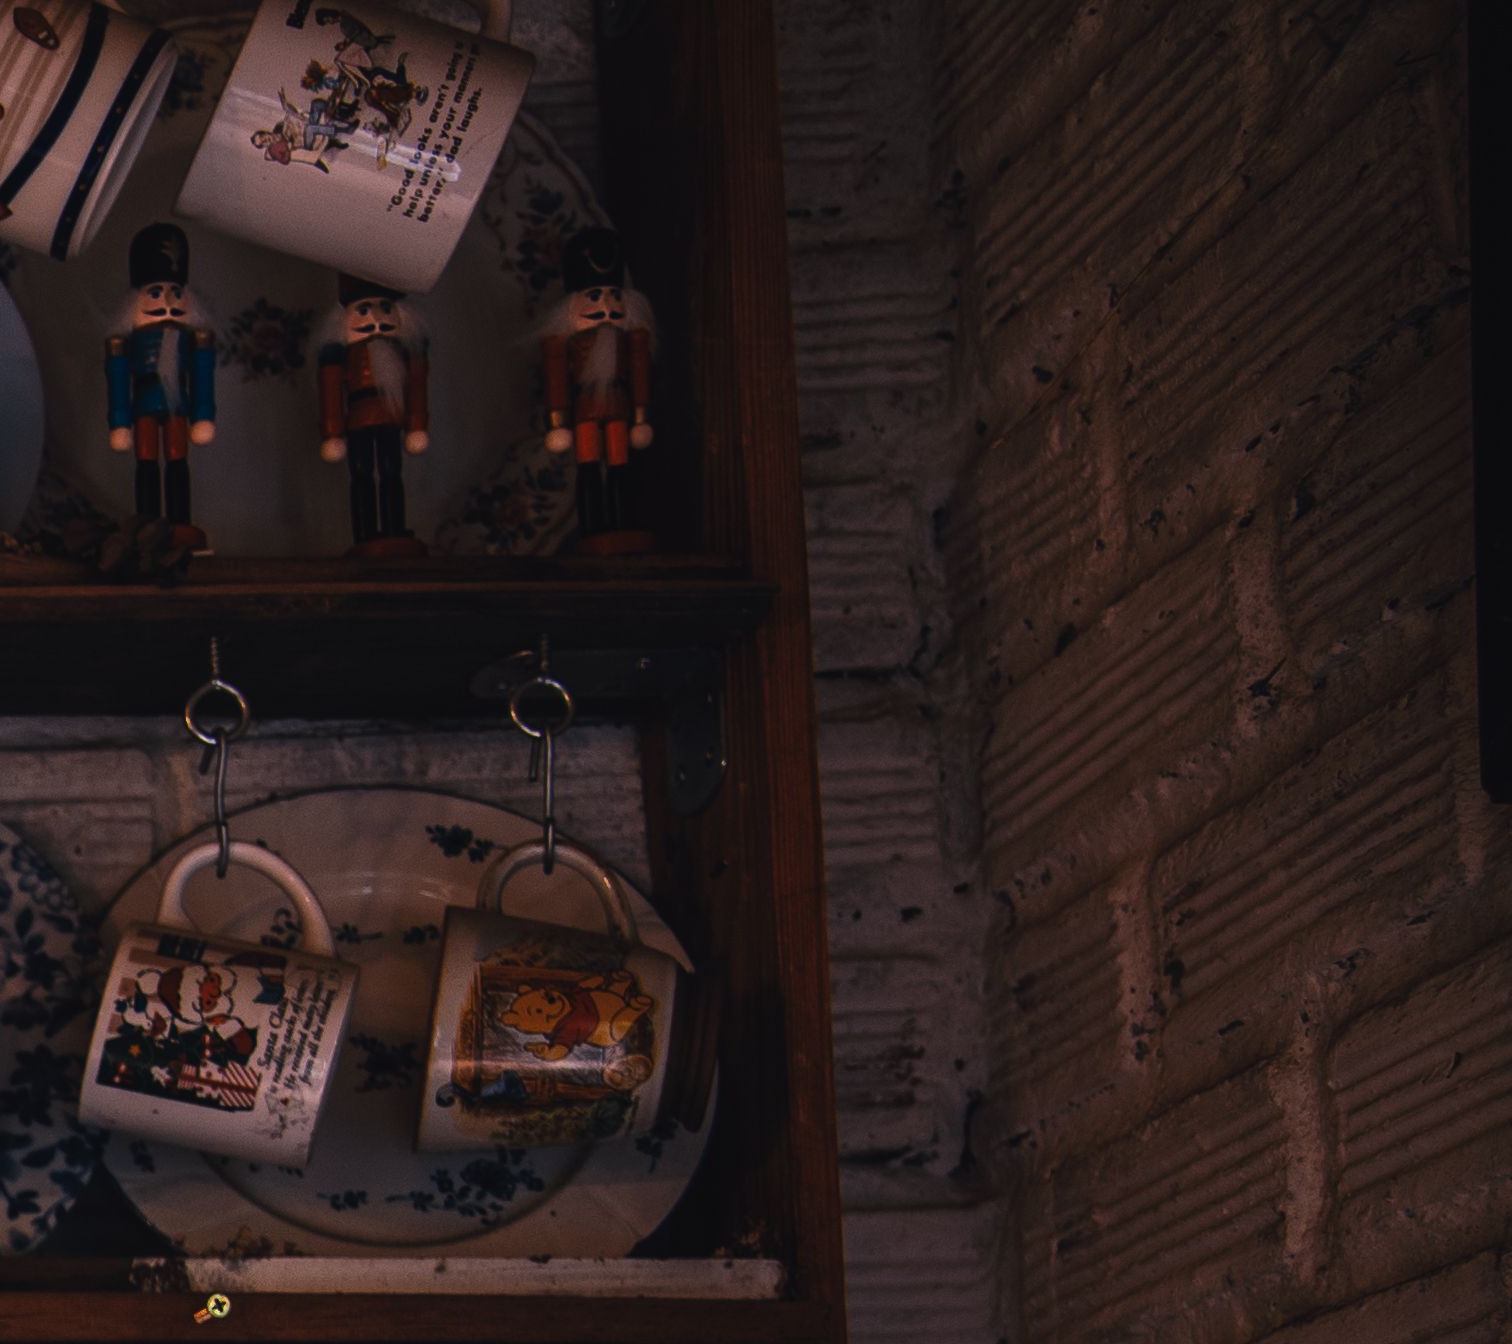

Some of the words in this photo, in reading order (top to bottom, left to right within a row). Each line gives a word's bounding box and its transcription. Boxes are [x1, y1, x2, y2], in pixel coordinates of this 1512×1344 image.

[446, 136, 463, 164] dad
[457, 87, 483, 133] laughs.
[403, 188, 425, 219] help
[420, 143, 444, 187] unless
[441, 109, 457, 141] your
[410, 127, 433, 165] looks
[257, 1032, 278, 1071] Santa
[283, 1073, 296, 1089] He
